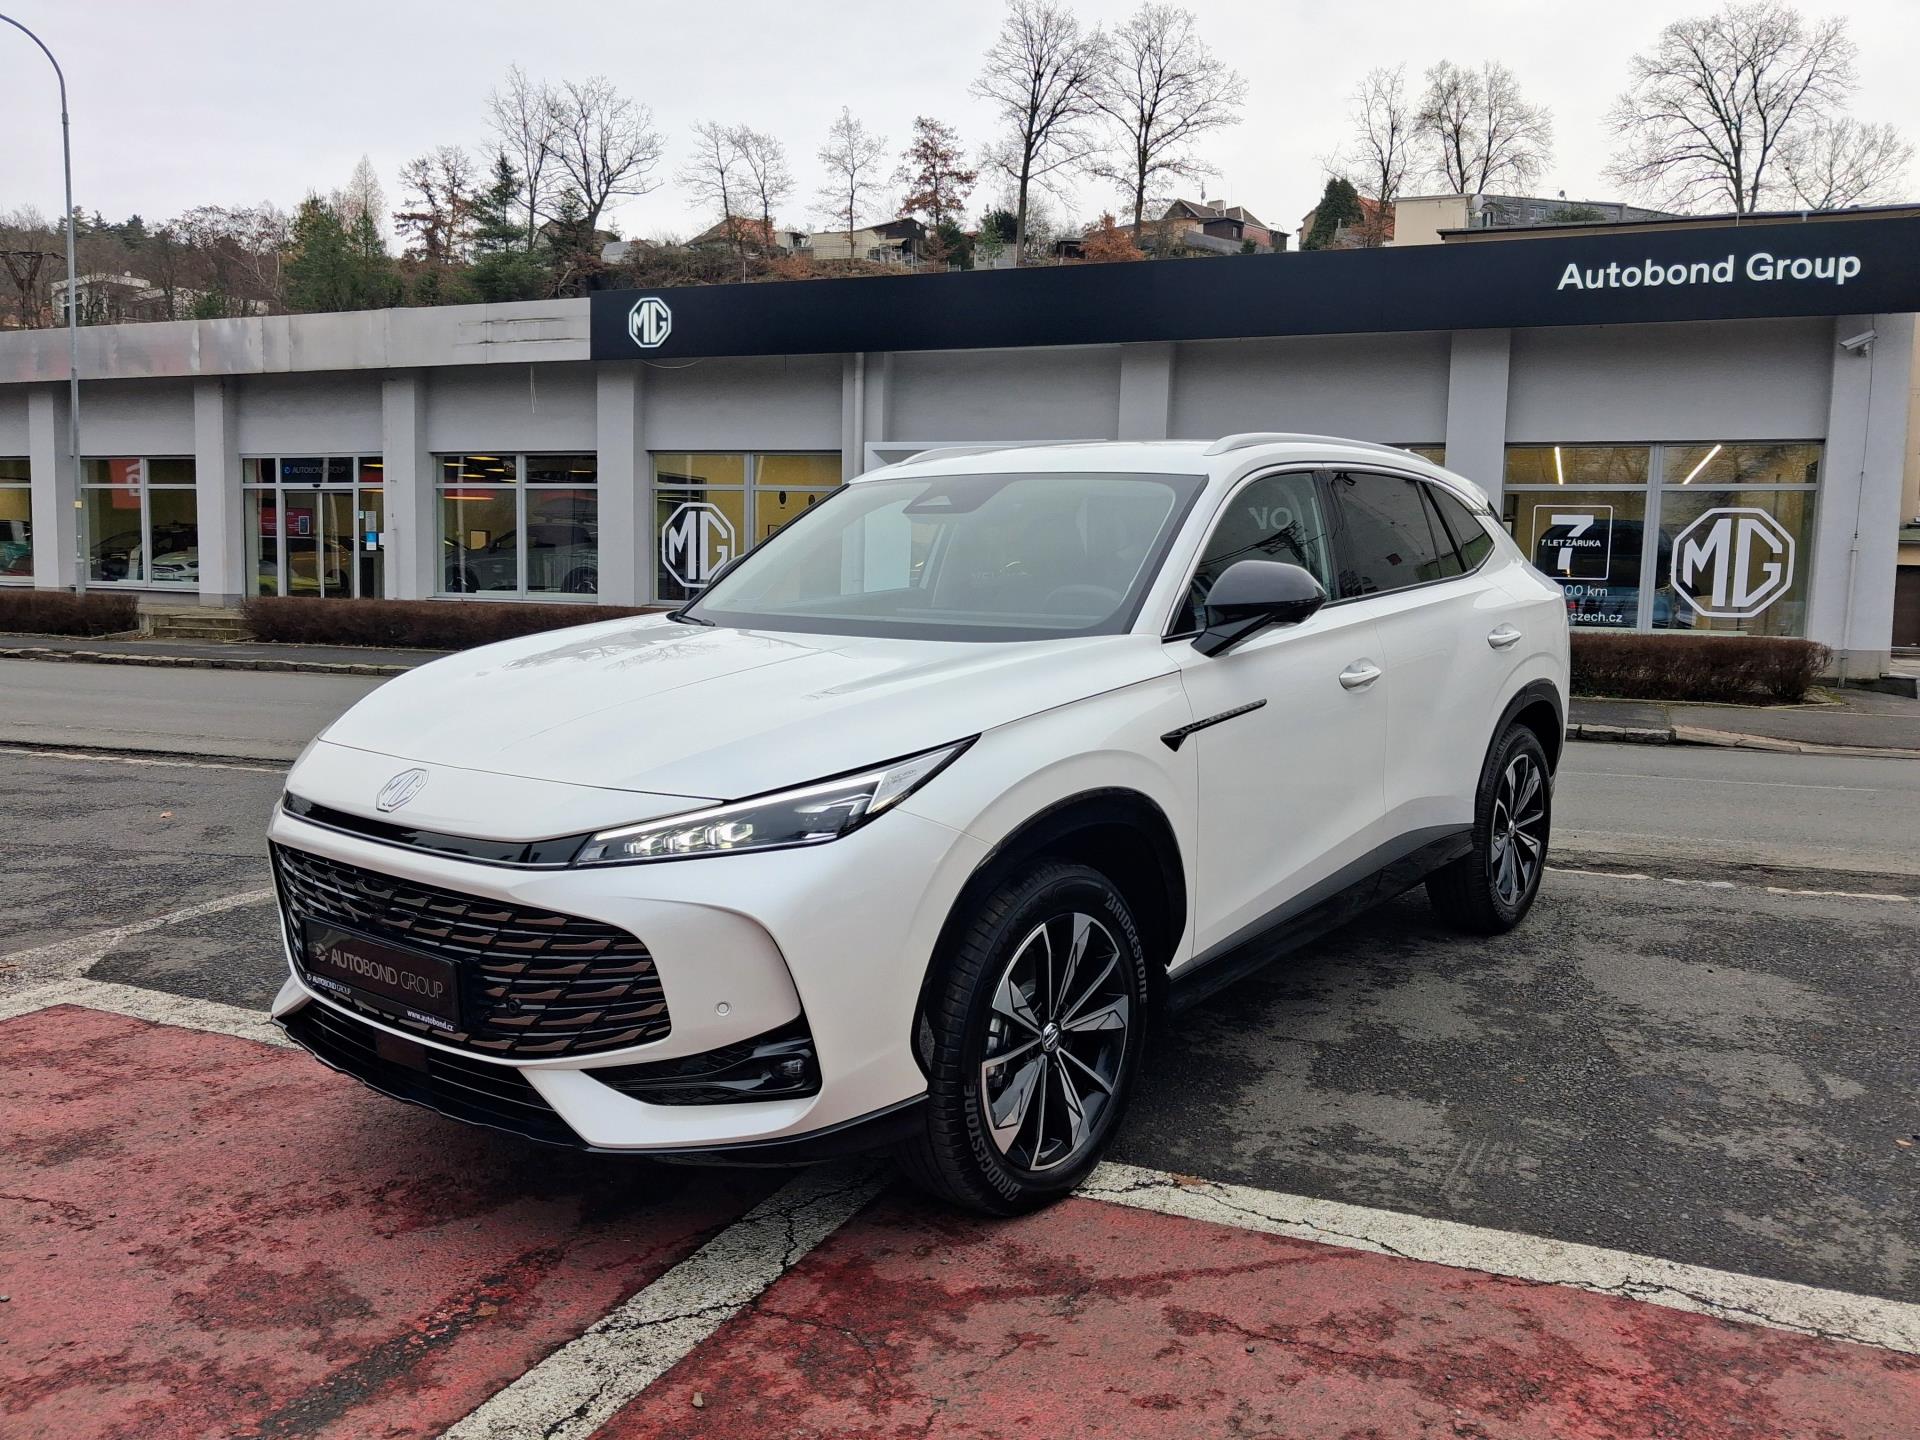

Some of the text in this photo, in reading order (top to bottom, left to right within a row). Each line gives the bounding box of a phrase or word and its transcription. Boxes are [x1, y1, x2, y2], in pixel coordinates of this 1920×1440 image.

[1556, 252, 1861, 290] Autobond Group
[632, 301, 668, 344] MG
[668, 510, 728, 579] MG
[1547, 539, 1564, 547] LET
[1565, 537, 1601, 547] ZÁRUKA
[1550, 514, 1595, 570] 7
[1682, 517, 1783, 608] MG
[1587, 584, 1608, 597] km
[1103, 891, 1148, 1004] BRIDGESTONE
[312, 976, 336, 990] AUTOBOND
[331, 948, 443, 999] AUTOBOND GROUP
[406, 1009, 454, 1032] www.autobond.cz
